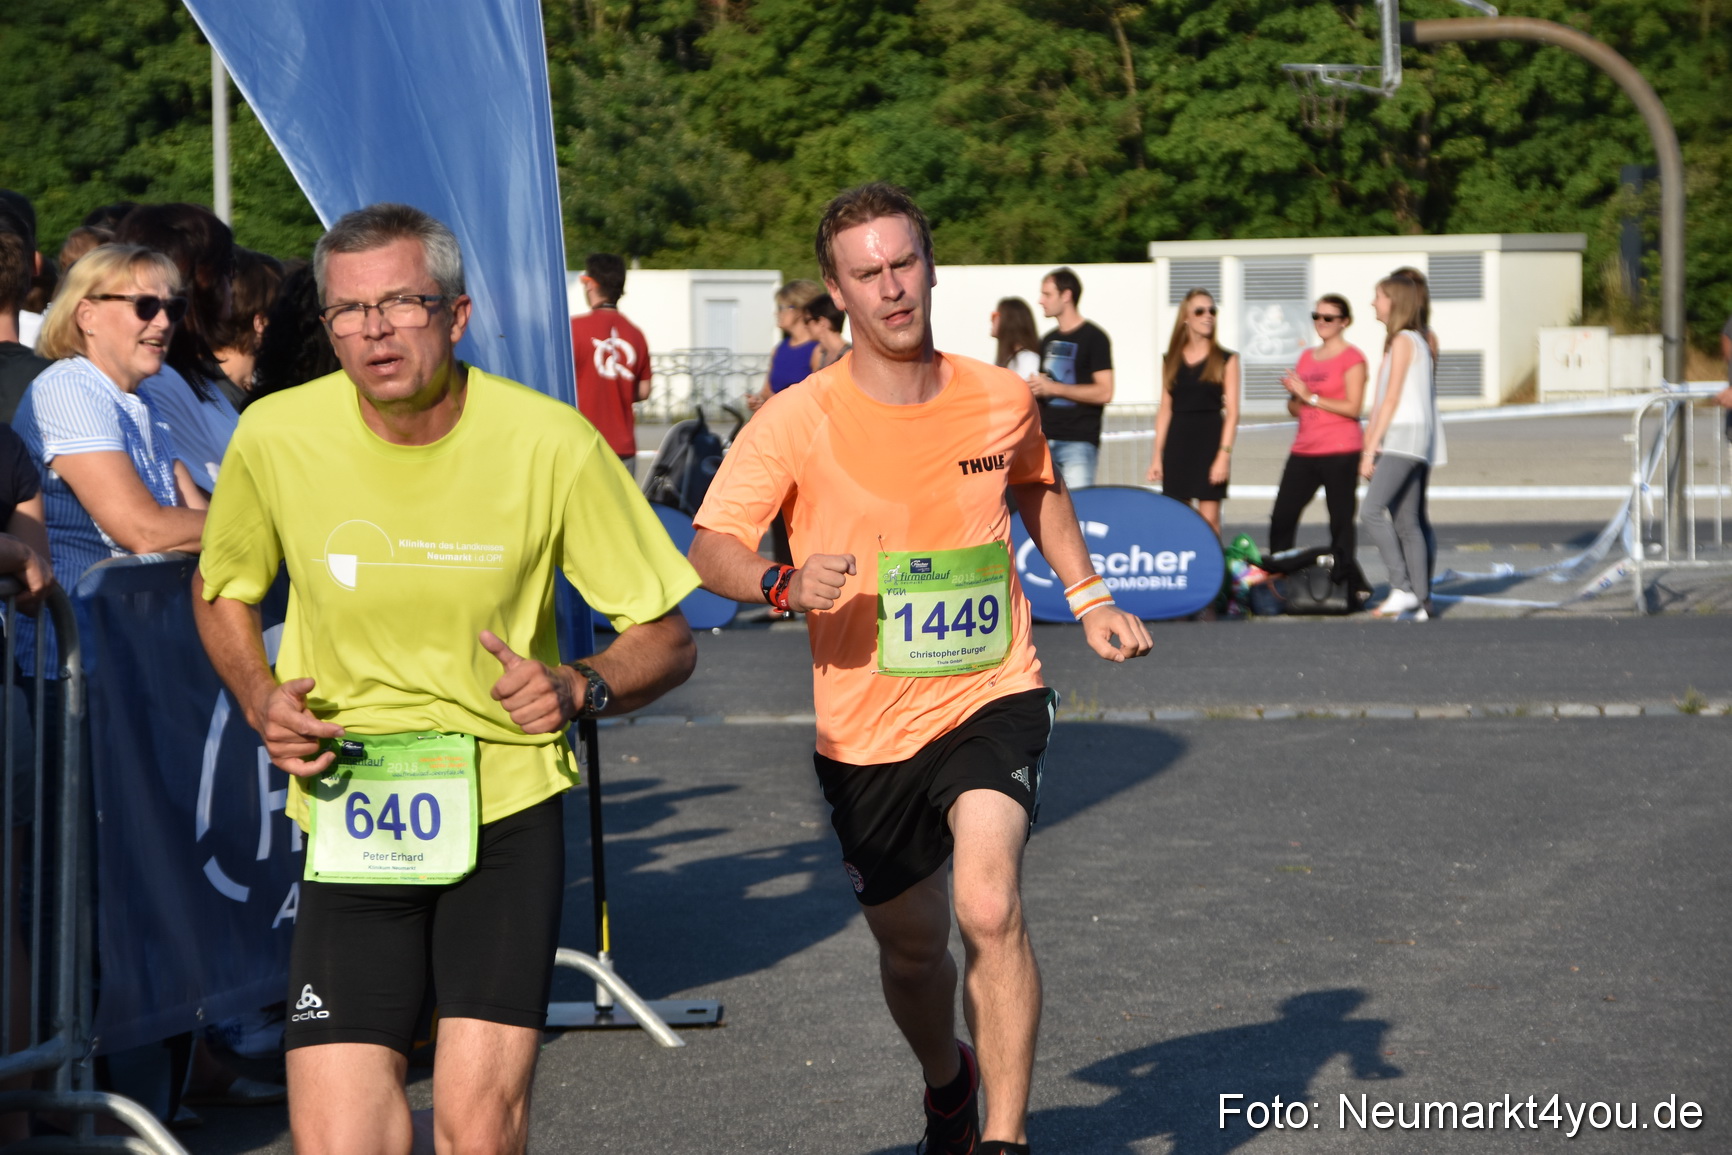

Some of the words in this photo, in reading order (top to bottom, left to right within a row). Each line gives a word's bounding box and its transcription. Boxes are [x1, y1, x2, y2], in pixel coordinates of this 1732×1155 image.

[959, 454, 1004, 475] THULE
[399, 539, 436, 549] Kliniken
[438, 541, 454, 550] des
[456, 542, 504, 552] Landkreises
[427, 552, 472, 562] Neumarkt
[1091, 545, 1196, 576] scher
[900, 570, 951, 582] firmenlauf
[952, 572, 975, 584] 2015
[1105, 576, 1188, 592] OMOBILE
[894, 594, 999, 642] 1449
[910, 649, 960, 659] Christopher
[961, 645, 986, 656] Burger
[386, 761, 419, 774] 2015
[345, 791, 441, 841] 640
[362, 851, 389, 861] Peter
[390, 852, 424, 862] Erhard
